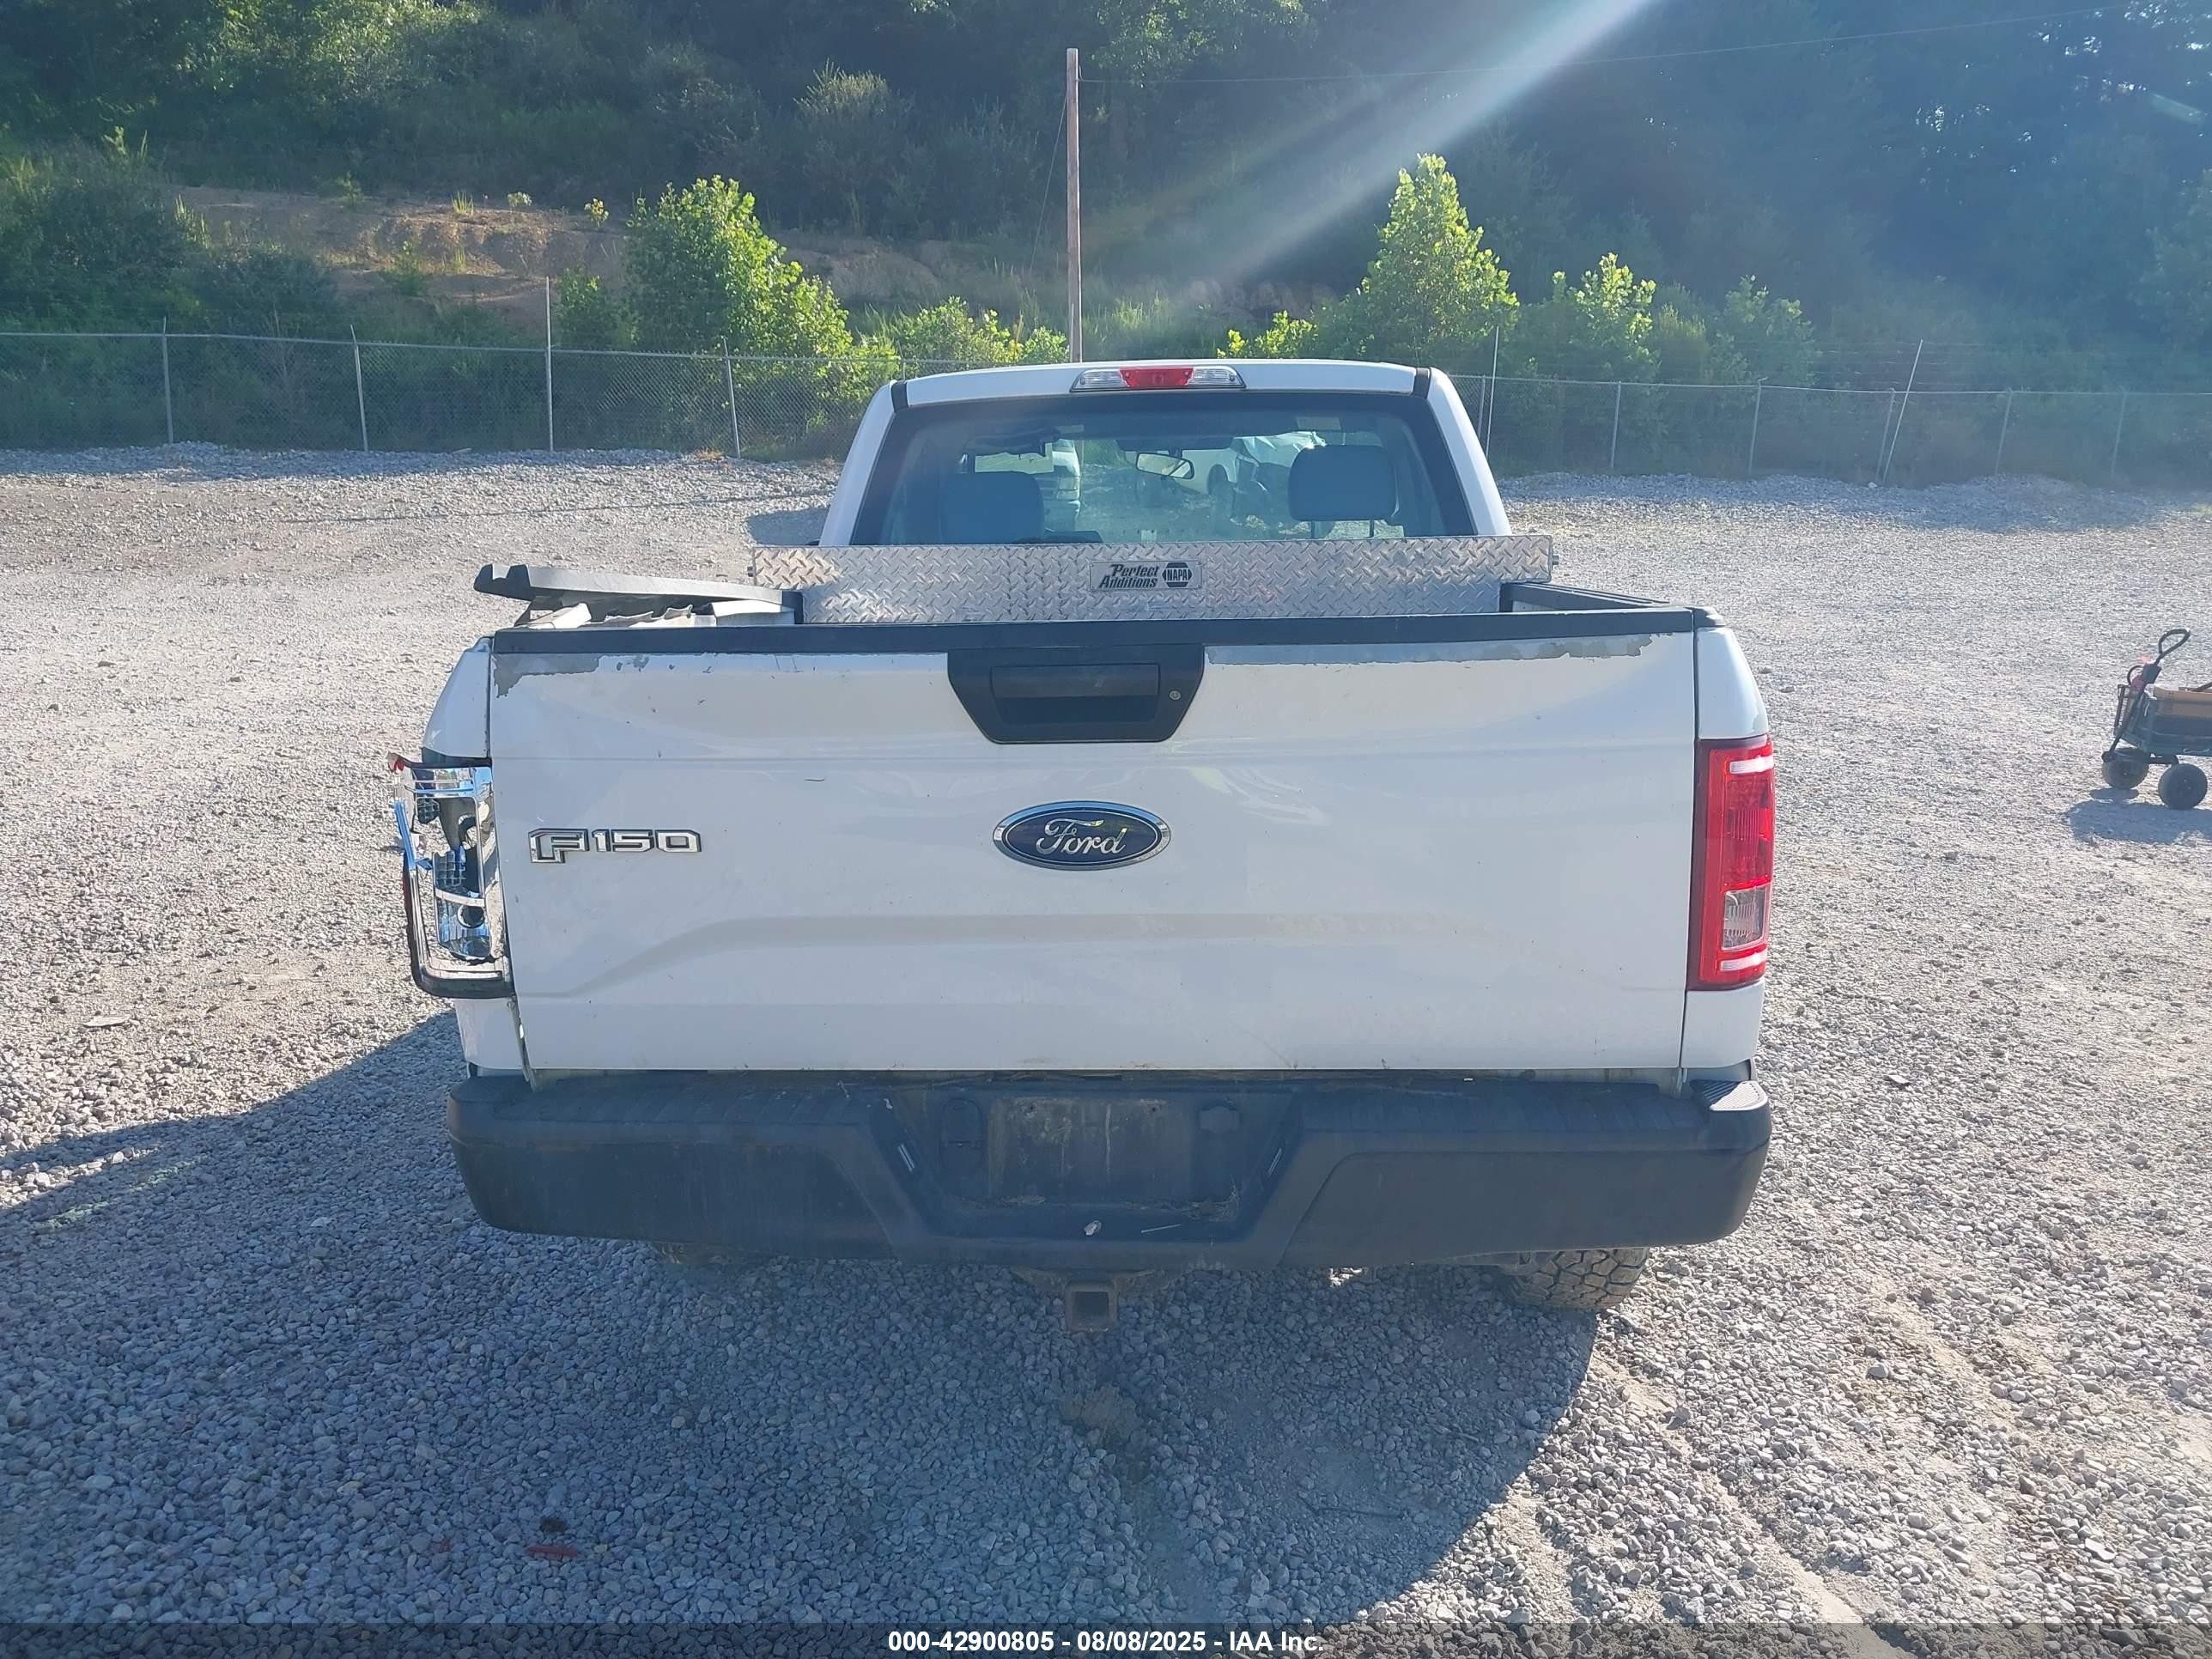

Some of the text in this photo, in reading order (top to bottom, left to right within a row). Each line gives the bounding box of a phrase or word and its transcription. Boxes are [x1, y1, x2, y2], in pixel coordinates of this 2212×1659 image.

[1110, 563, 1159, 578] Perfect
[1166, 568, 1188, 581] NAPA
[1098, 575, 1158, 588] Additions
[1036, 817, 1127, 854] Ford
